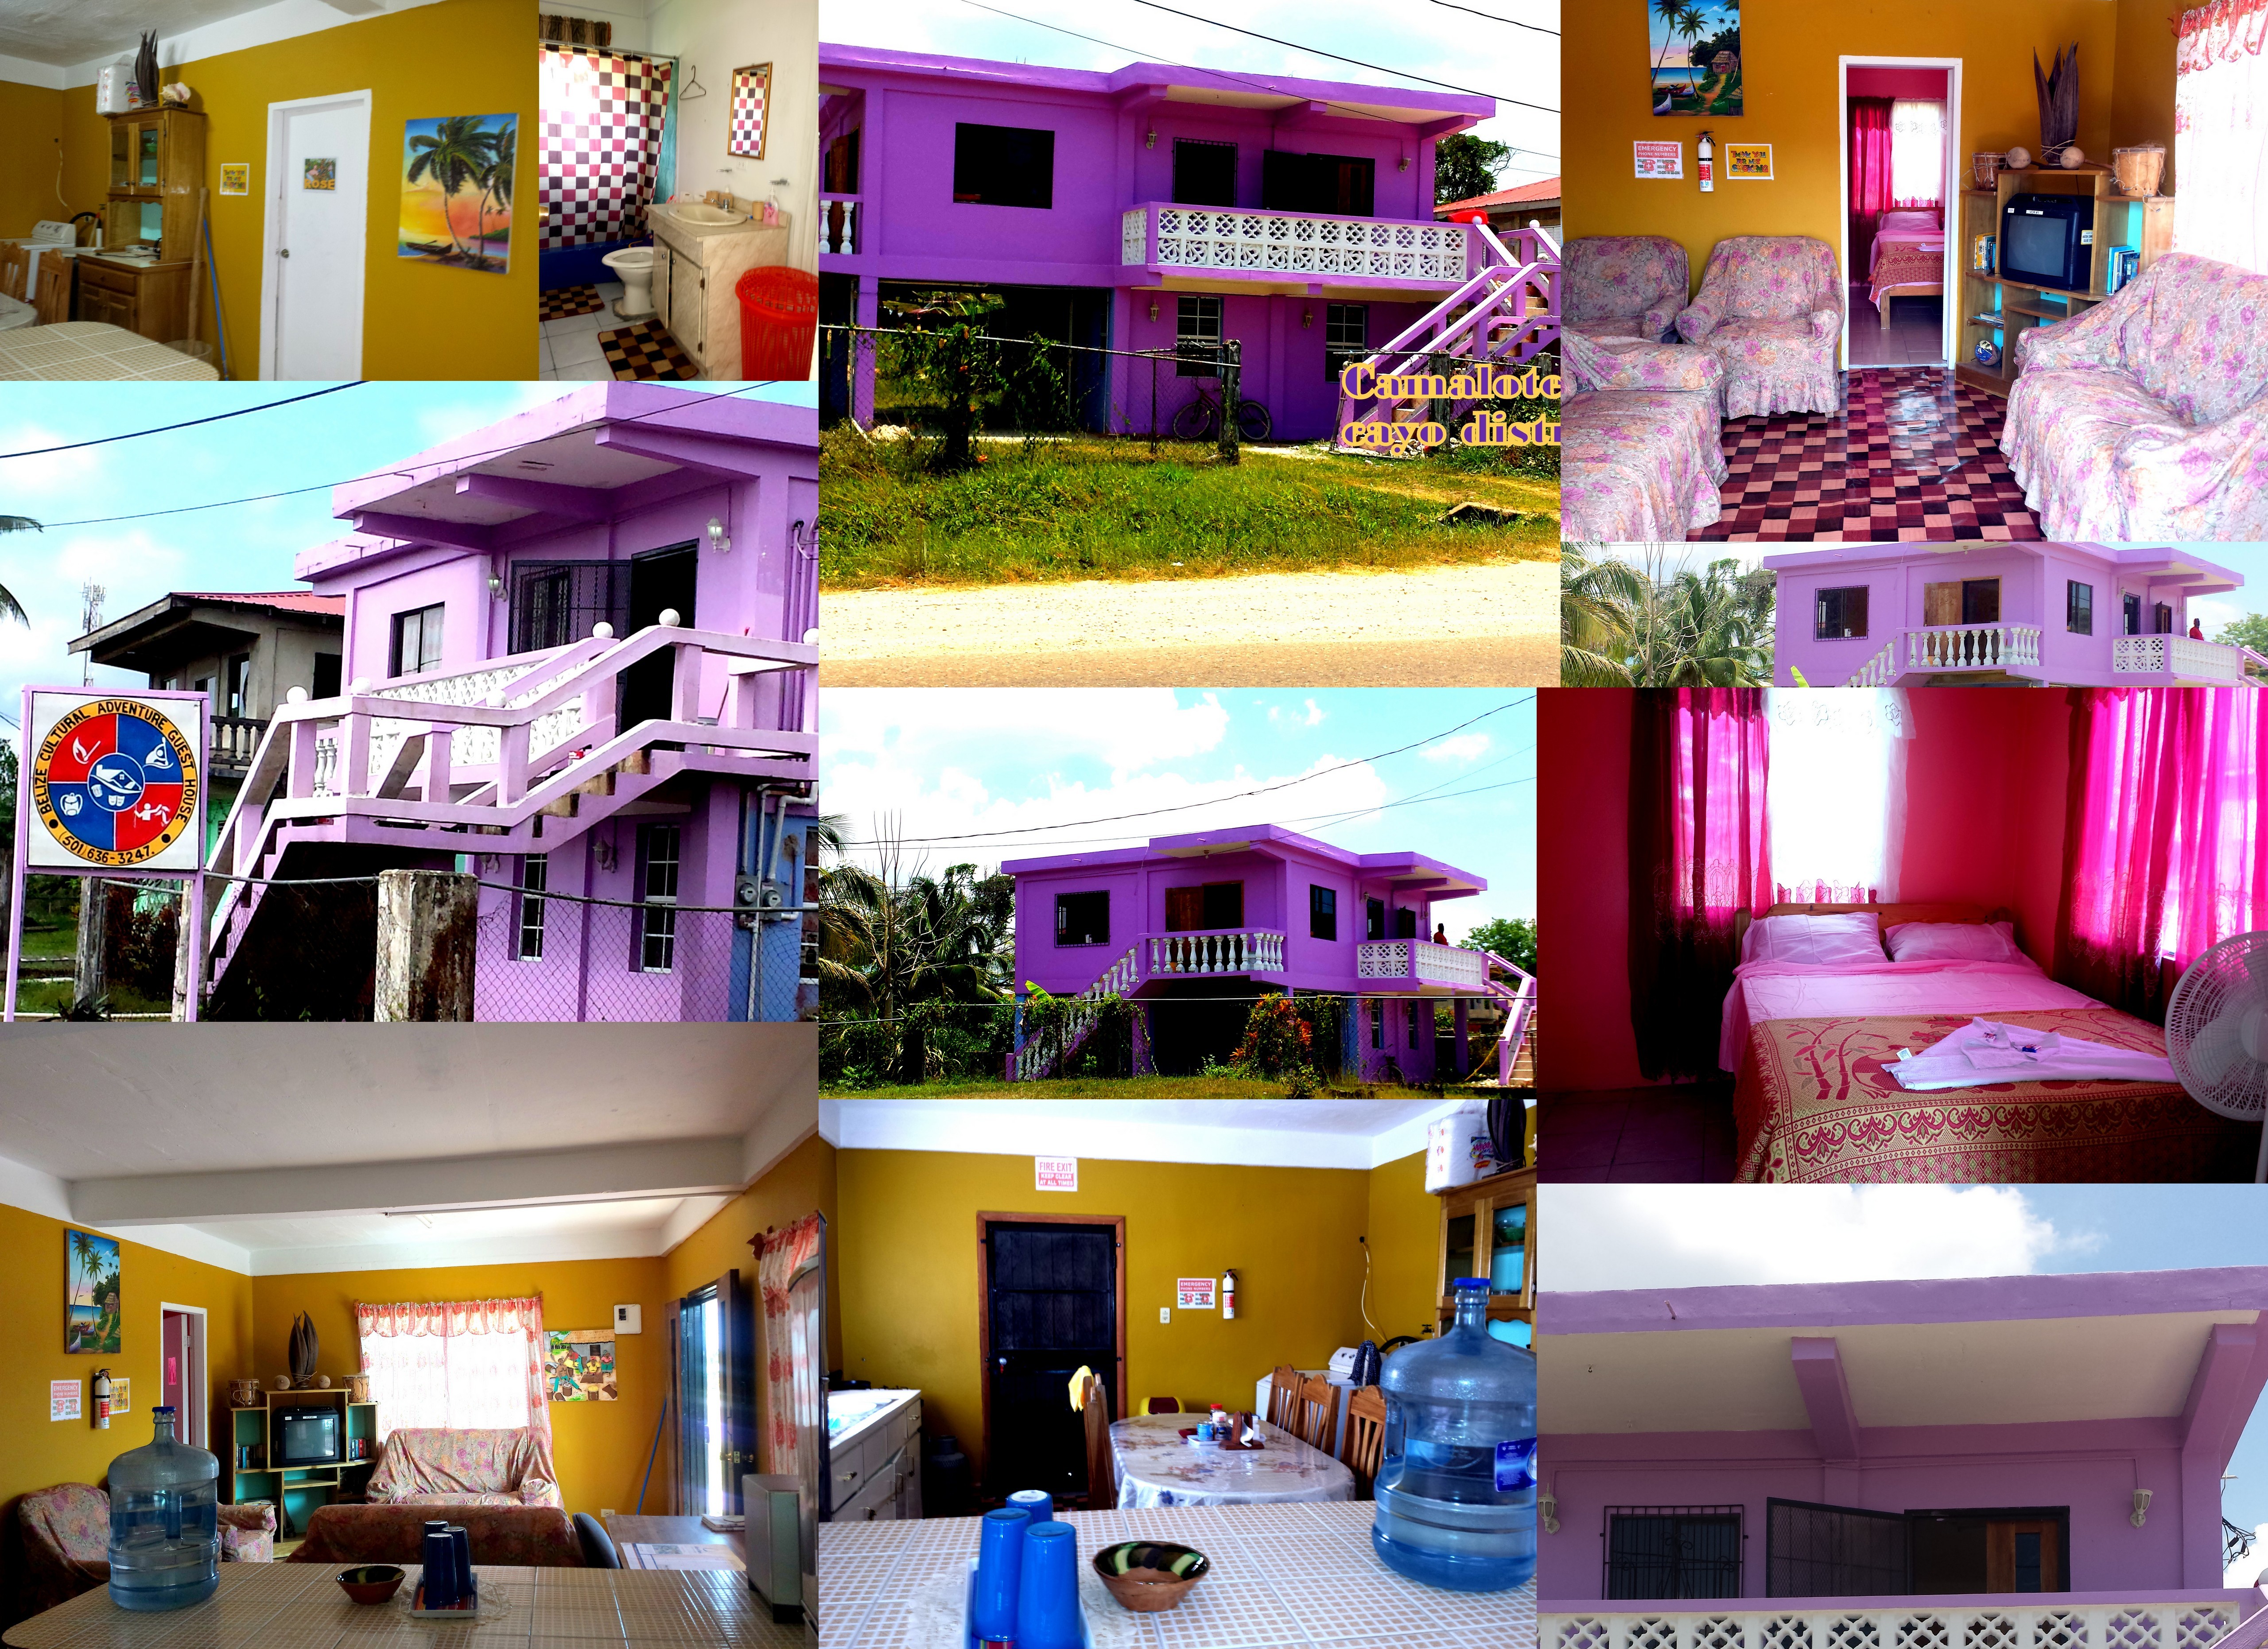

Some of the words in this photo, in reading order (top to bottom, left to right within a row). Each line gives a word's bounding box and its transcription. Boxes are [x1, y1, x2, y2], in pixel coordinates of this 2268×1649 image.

[1731, 164, 1768, 173] SMOKING
[304, 178, 335, 190] ROSE
[97, 701, 167, 730] ADVENTURE
[40, 709, 91, 761] CULTURAL
[168, 729, 194, 769] GUEST
[35, 768, 52, 814] BELIZE
[175, 779, 196, 823] HOUSE
[58, 831, 87, 855] (501)
[1039, 1162, 1055, 1171] FIRE
[1057, 1163, 1072, 1172] EXIT
